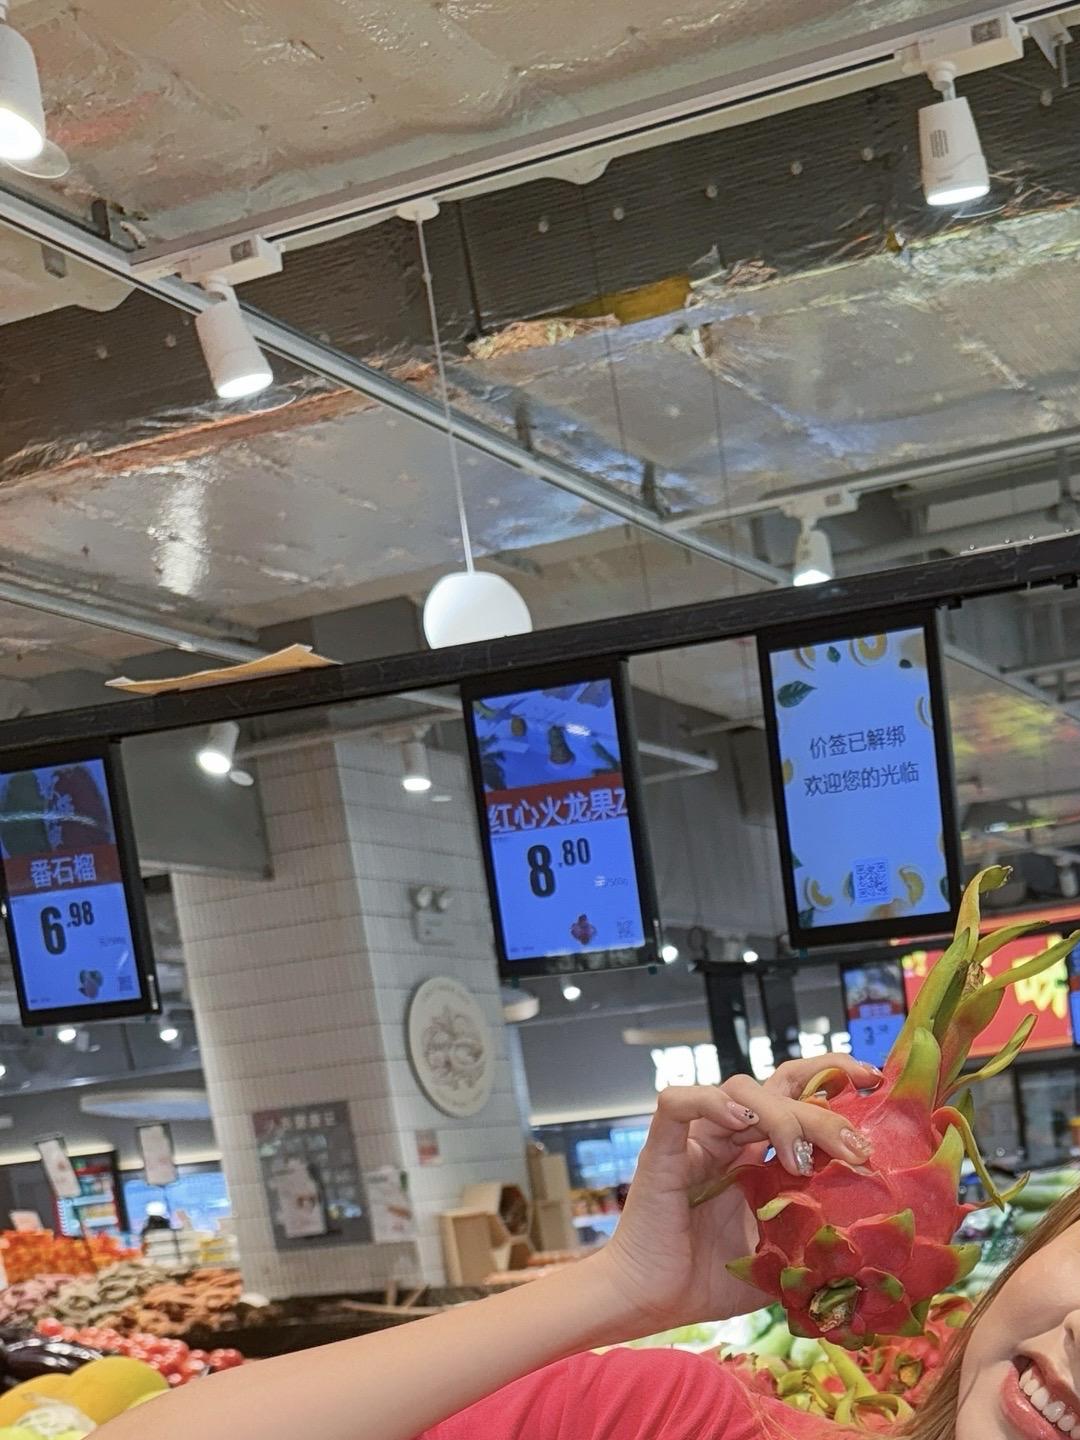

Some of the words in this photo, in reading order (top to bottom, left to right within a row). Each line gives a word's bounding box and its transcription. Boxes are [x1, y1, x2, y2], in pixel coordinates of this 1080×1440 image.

[810, 725, 906, 760] 价签已解绑
[803, 761, 920, 797] 欢迎您的光临
[30, 853, 97, 889] 番石榴
[527, 837, 592, 898] 8.80
[40, 901, 95, 956] 6.98
